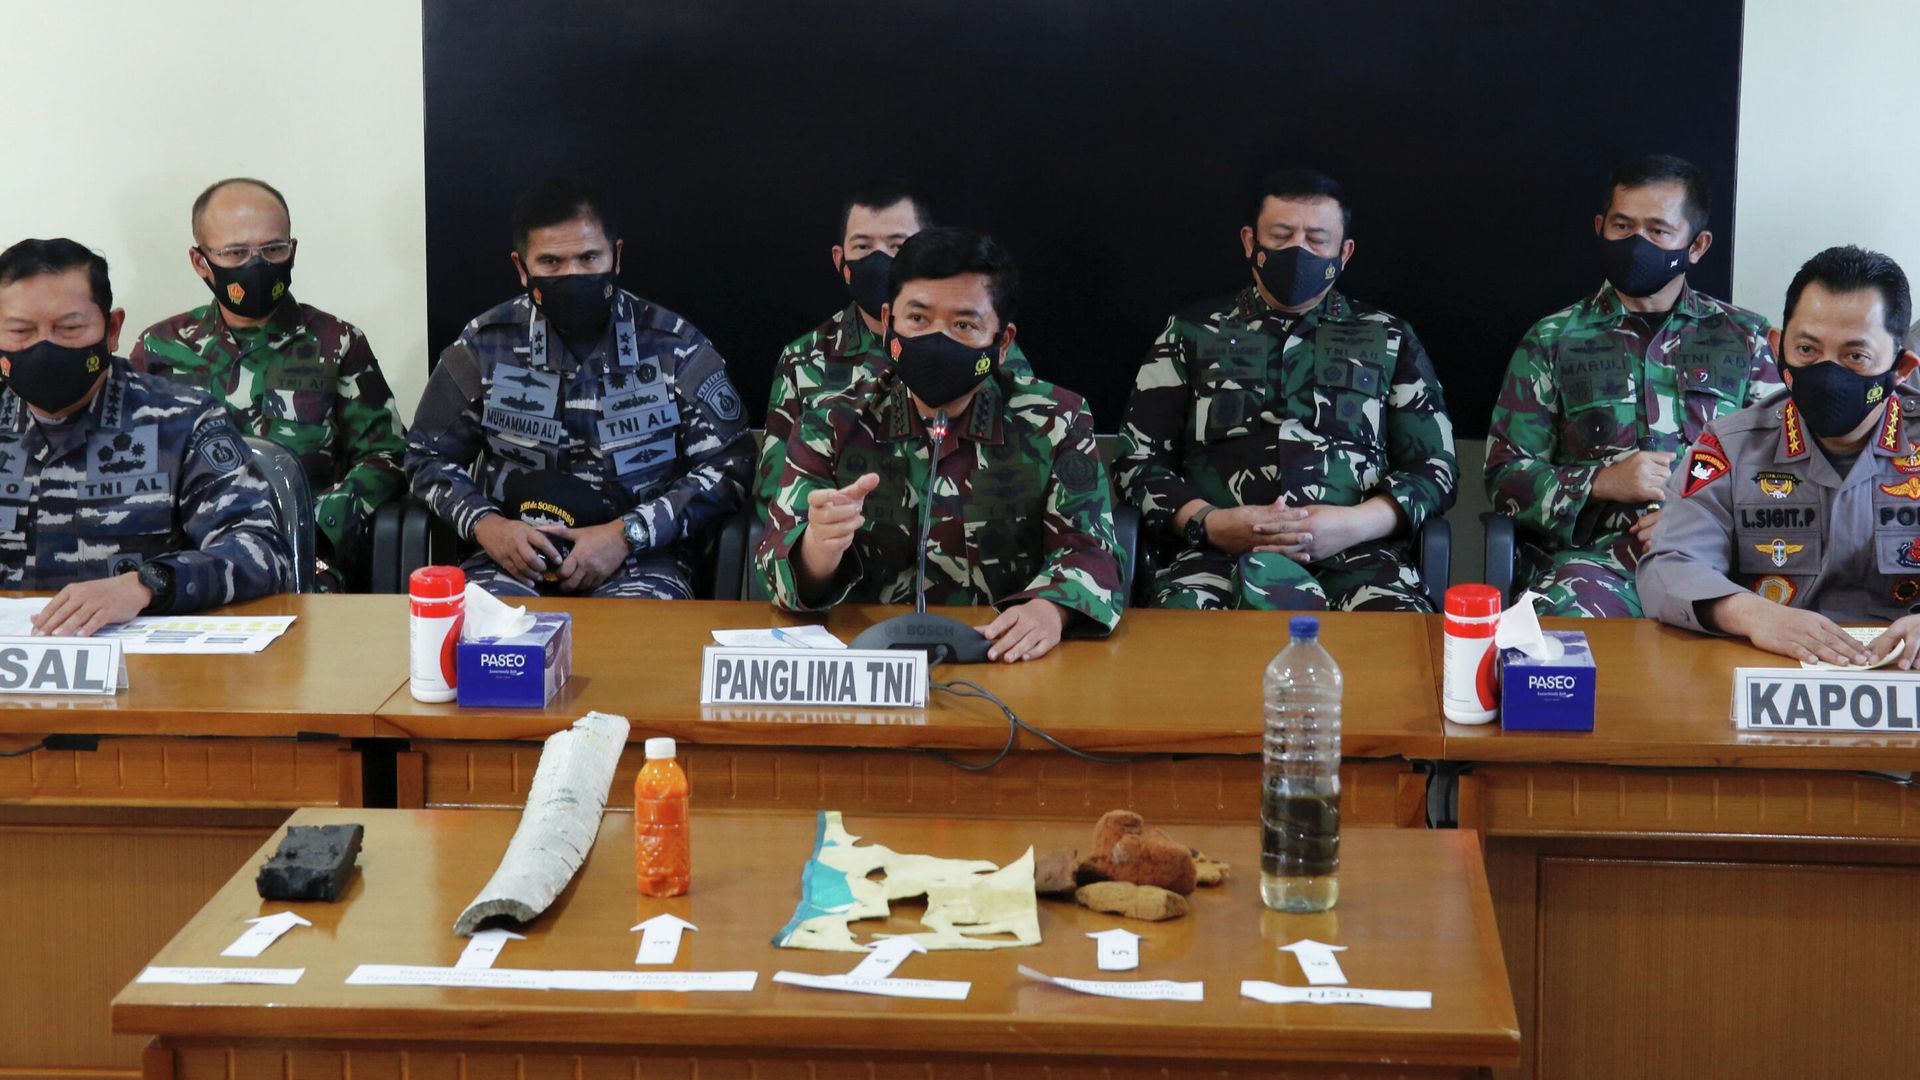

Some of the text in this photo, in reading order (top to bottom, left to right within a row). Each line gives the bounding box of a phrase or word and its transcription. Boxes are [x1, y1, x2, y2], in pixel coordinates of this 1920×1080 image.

[1560, 359, 1627, 376] MARULI
[1680, 354, 1747, 369] TNI AD
[485, 410, 557, 439] MUHAMMAD ALI
[606, 411, 672, 437] TNI AL
[85, 477, 162, 497] TNI AL
[538, 501, 575, 527] SOEHARSO
[1880, 505, 1920, 527] PO
[906, 624, 955, 637] BOSCH
[0, 648, 105, 690] SAL
[480, 653, 526, 668] PASEO
[715, 659, 914, 703] PANGLIMA TNI
[1529, 675, 1576, 690] PASEO
[1750, 682, 1920, 729] KAPOL
